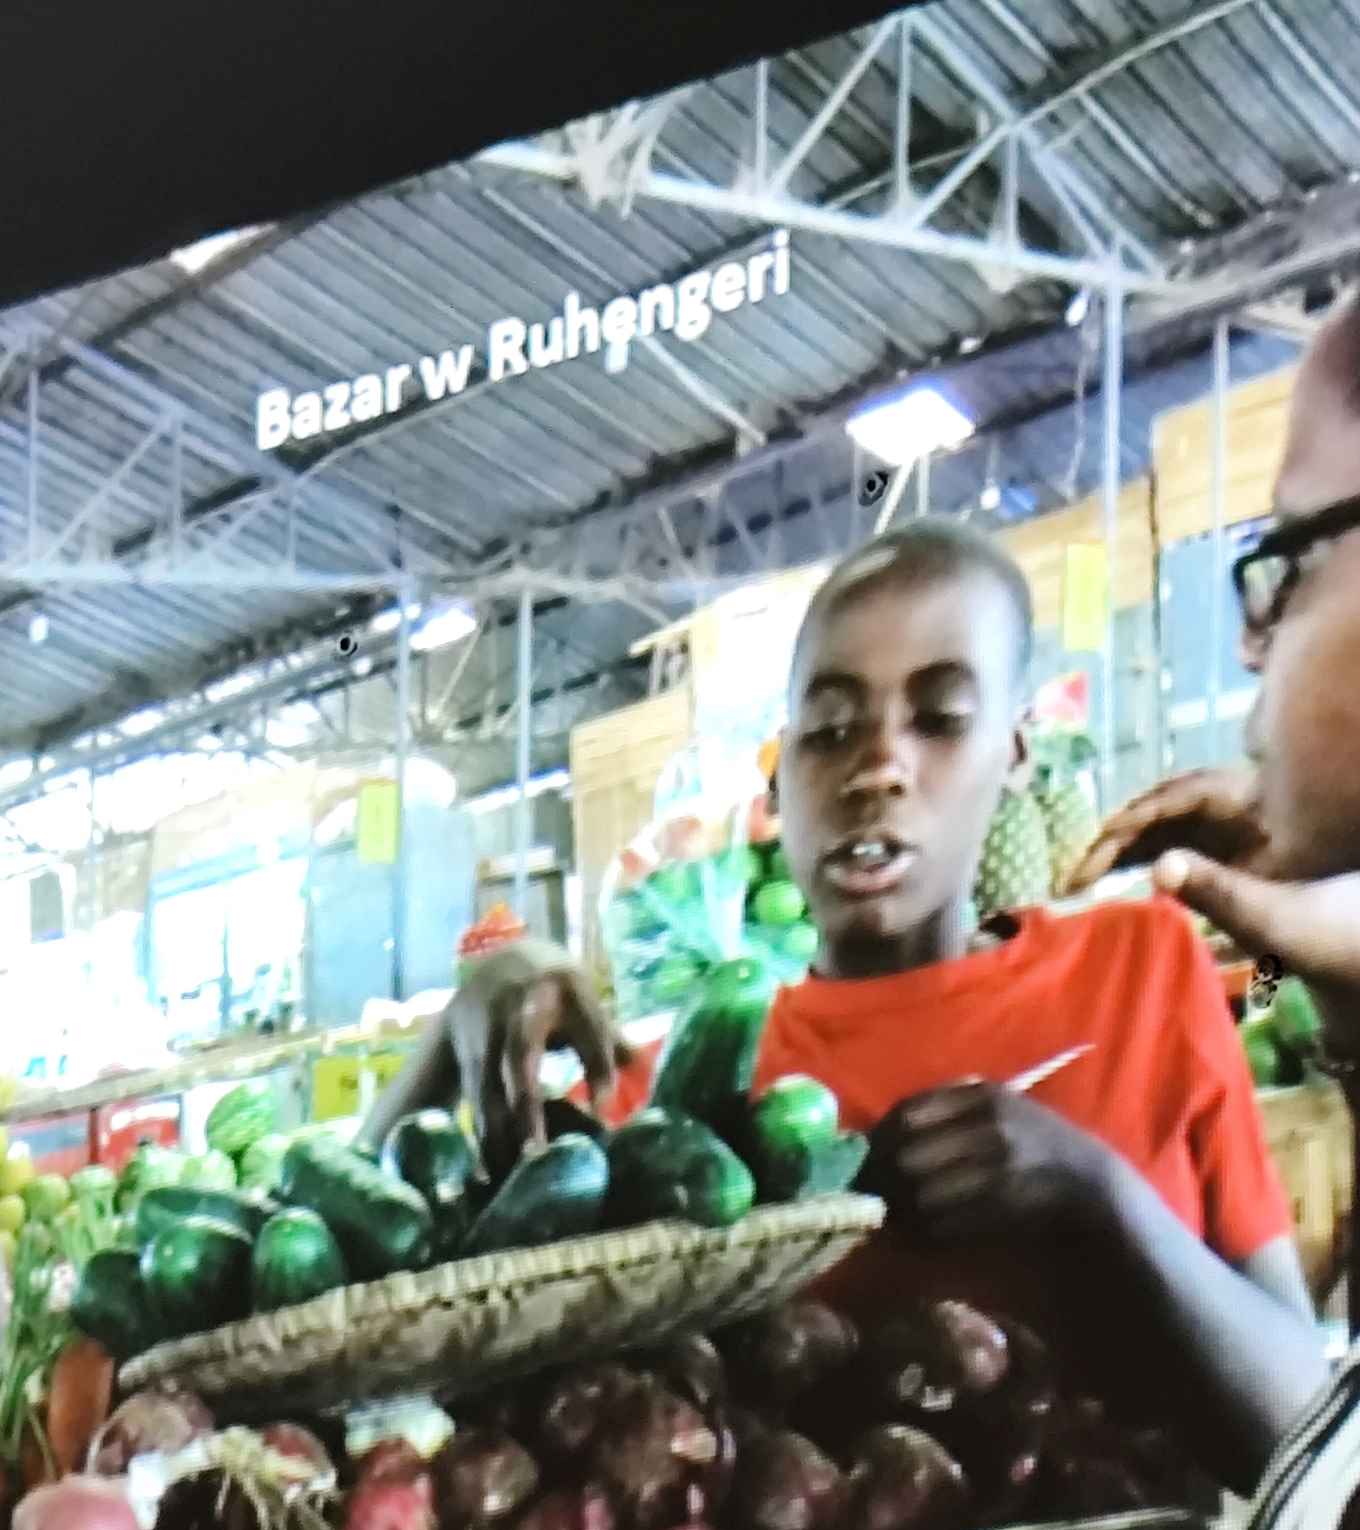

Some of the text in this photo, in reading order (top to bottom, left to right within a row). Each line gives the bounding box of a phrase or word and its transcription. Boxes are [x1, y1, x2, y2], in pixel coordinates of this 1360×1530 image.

[256, 229, 790, 450] Bazar w Ruhengeri
